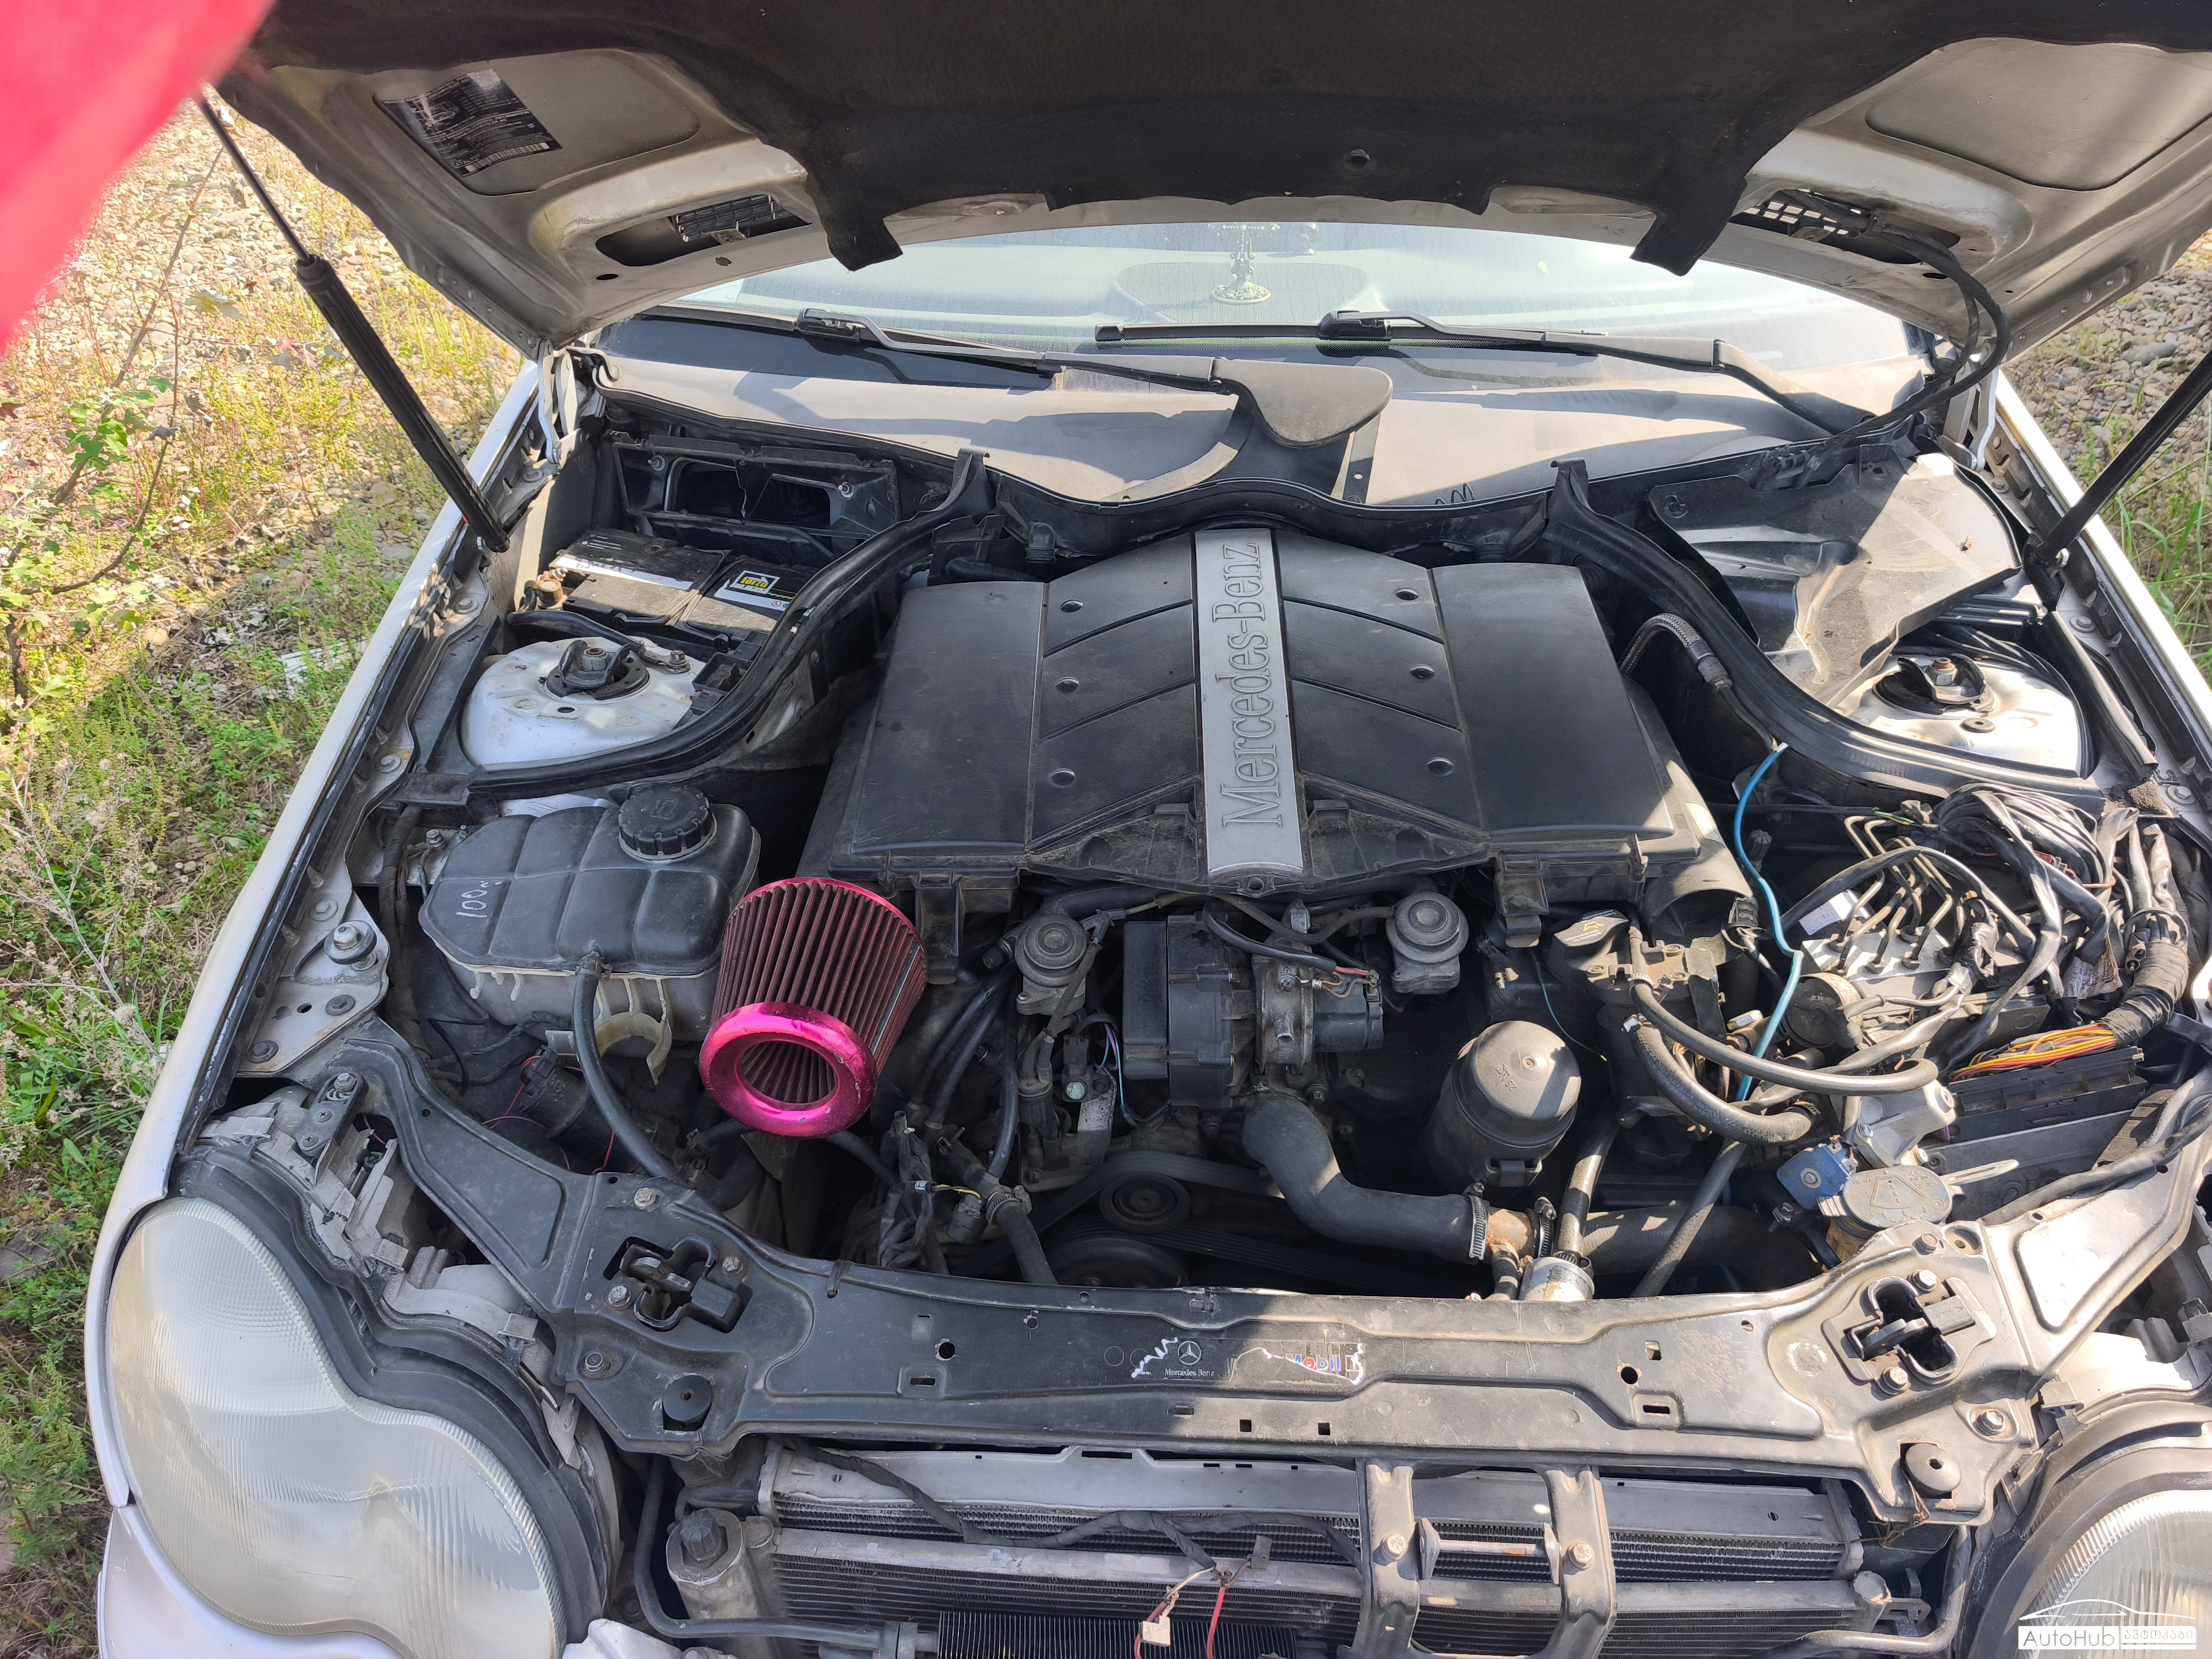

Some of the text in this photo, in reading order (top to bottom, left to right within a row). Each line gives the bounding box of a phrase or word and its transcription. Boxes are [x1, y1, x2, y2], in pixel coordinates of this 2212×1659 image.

[1212, 542, 1283, 828] Mercedes-Benz
[1505, 1080, 1518, 1091] 25
[1164, 1368, 1215, 1377] Mercedes Benz
